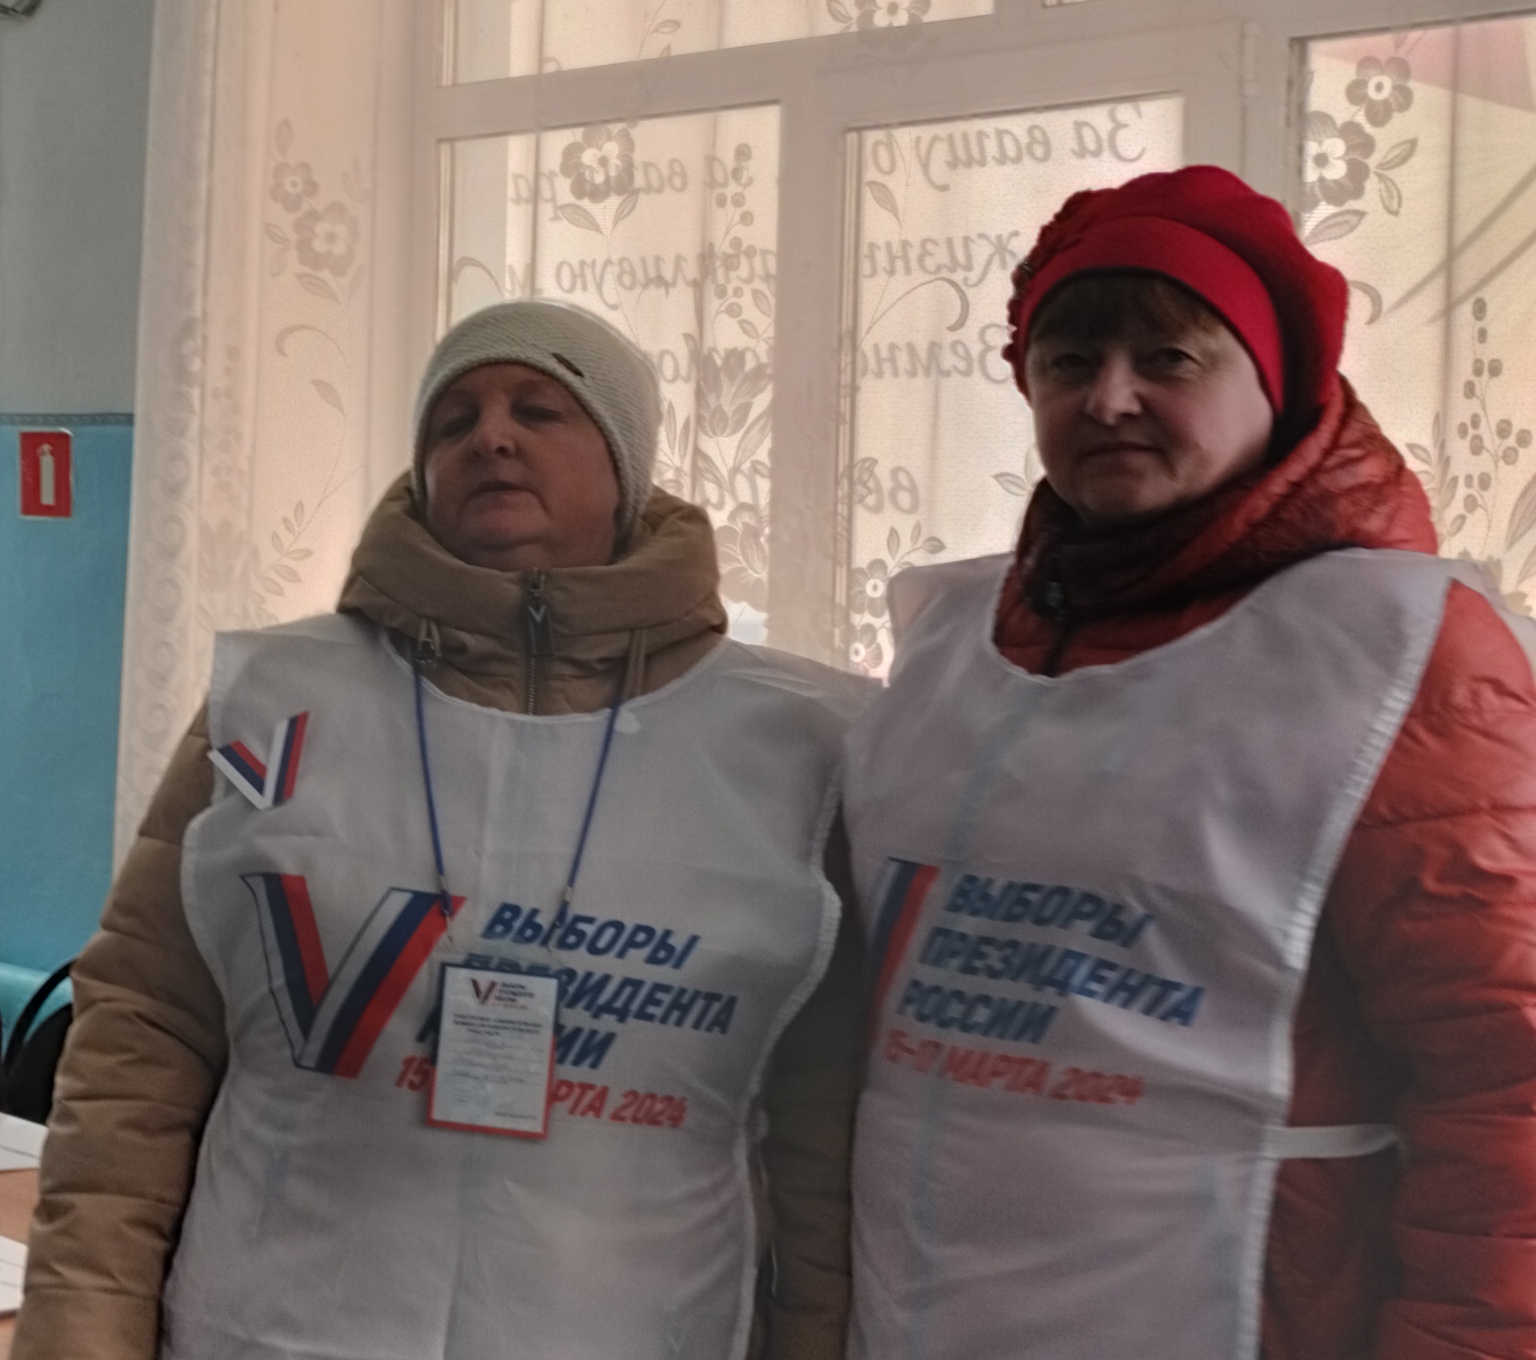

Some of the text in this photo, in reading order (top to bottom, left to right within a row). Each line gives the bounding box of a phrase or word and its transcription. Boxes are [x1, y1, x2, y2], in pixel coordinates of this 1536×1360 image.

[944, 873, 1154, 949] ВЫБОРЫ
[465, 952, 738, 1036] ЗИДЕНТА
[896, 977, 1059, 1045] РОССИИ
[918, 925, 1206, 1028] ПРЕЗИДЕНТА
